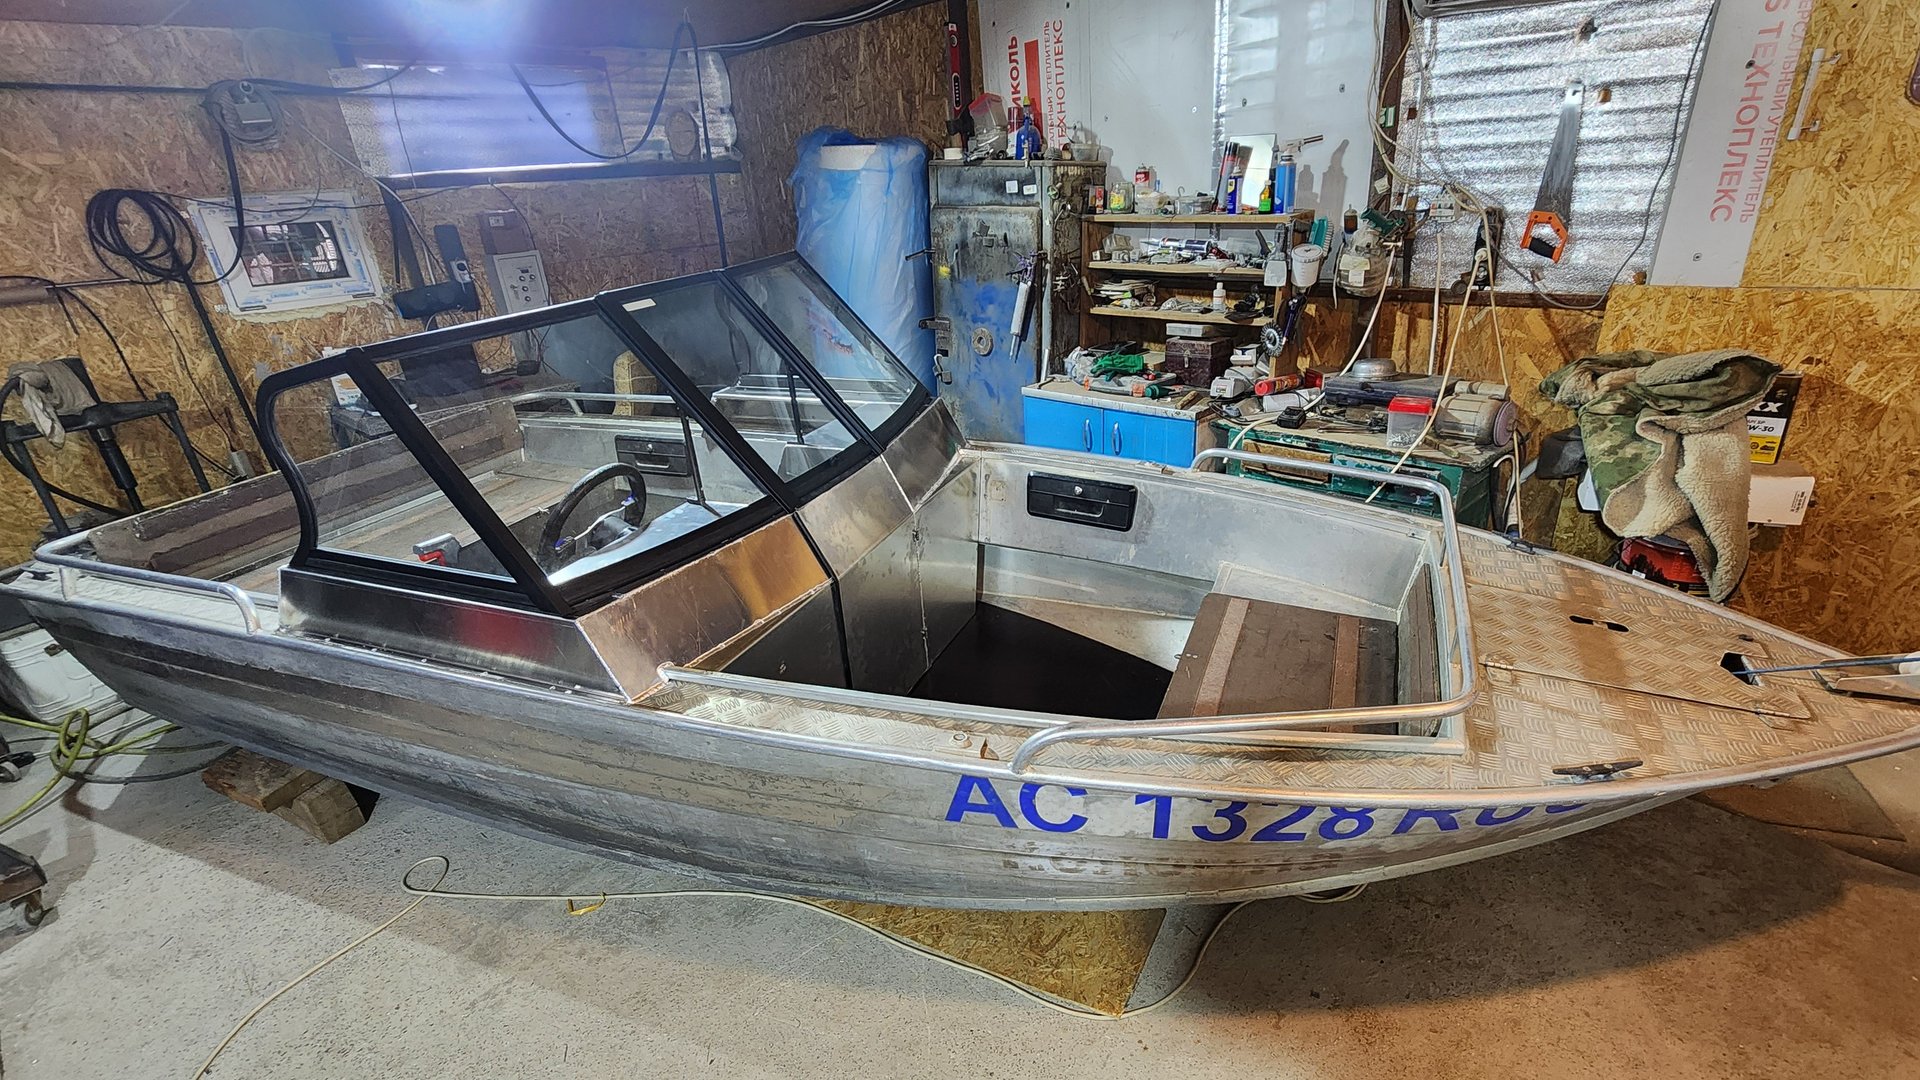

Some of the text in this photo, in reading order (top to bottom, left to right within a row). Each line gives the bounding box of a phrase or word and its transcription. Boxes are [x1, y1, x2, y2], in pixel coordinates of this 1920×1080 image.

[1008, 36, 1022, 107] ИКОЛЬ
[1709, 21, 1784, 223] ТЕХНОПЛЕКС
[1739, 0, 1813, 224] ЕРСАЛЬНЫЙ УТЕПЛИТЕЛЬ
[1747, 424, 1775, 433] W-30
[944, 775, 1590, 844] AC 1328 RU
